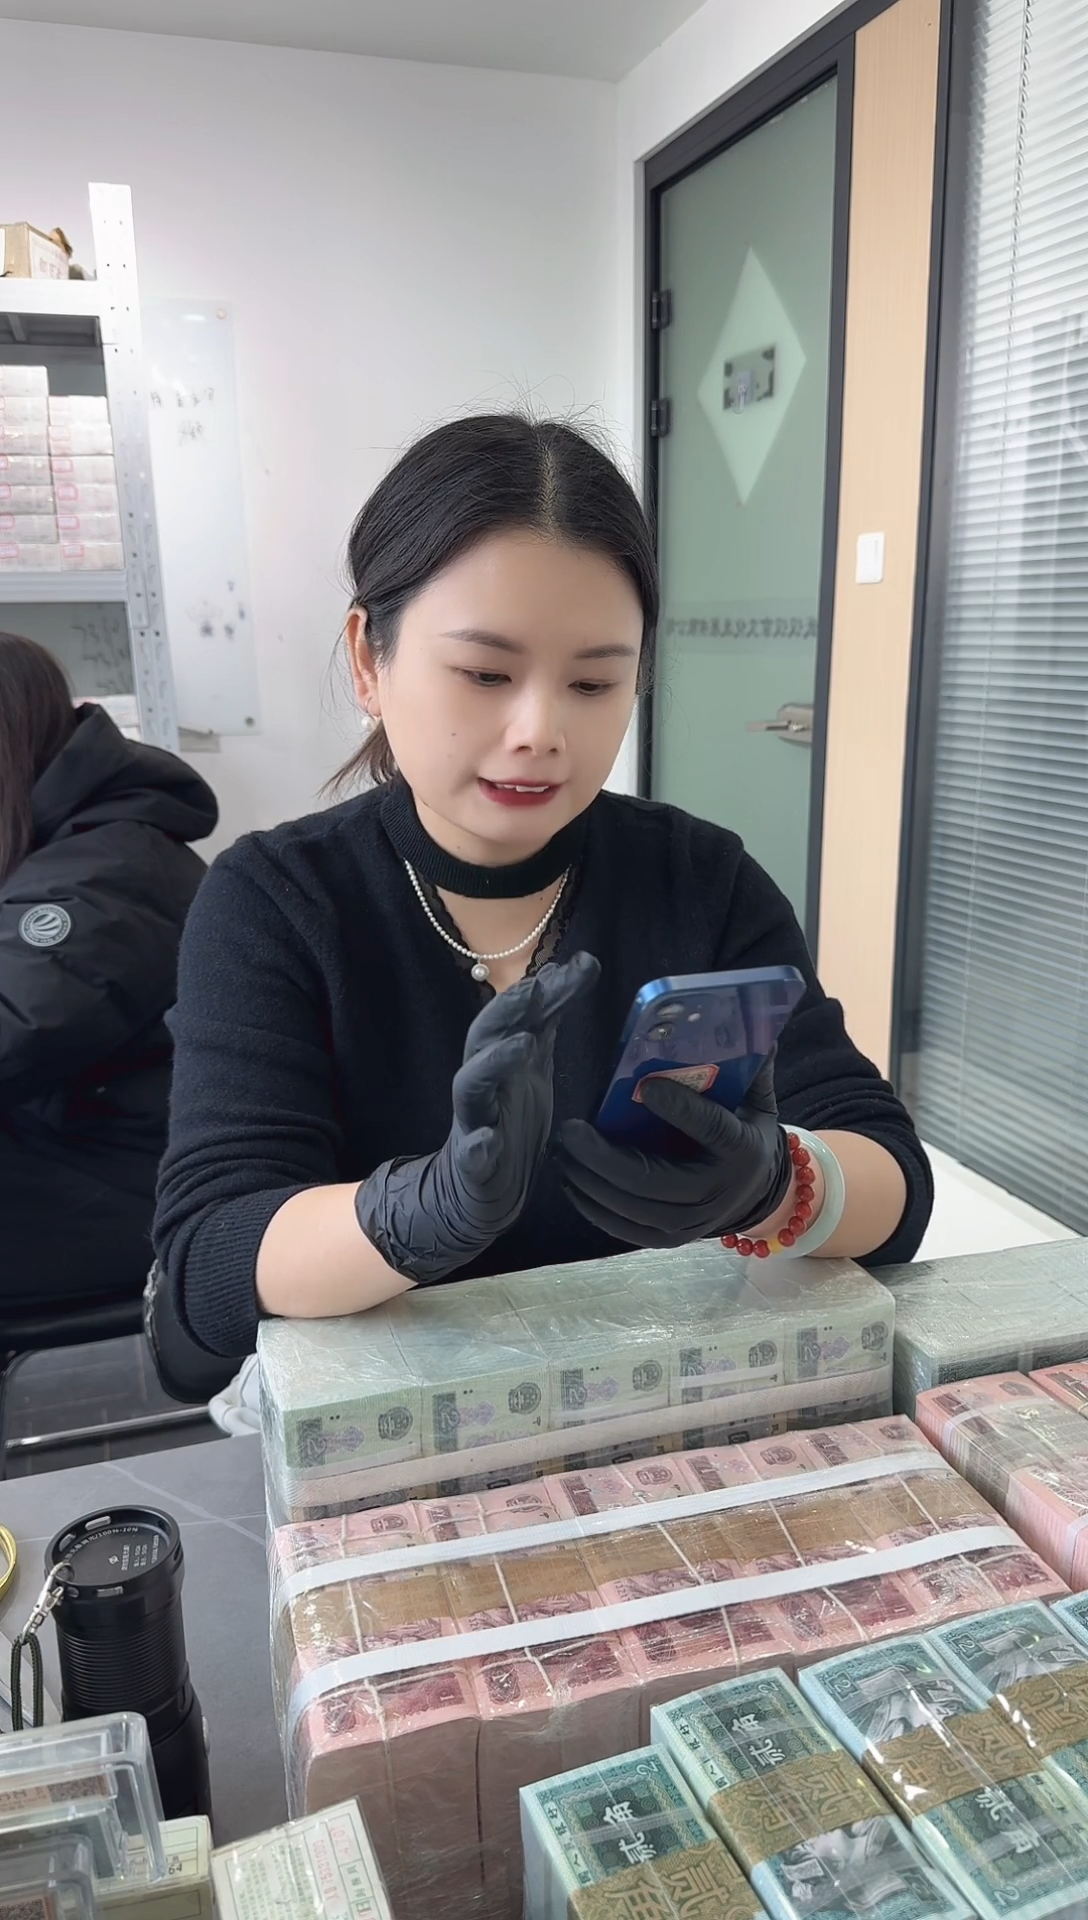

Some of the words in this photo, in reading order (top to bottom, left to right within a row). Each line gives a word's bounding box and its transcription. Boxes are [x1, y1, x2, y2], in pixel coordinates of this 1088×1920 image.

[758, 1681, 781, 1694] 2
[732, 1713, 786, 1767] 贰角
[636, 1761, 660, 1776] 2
[603, 1801, 657, 1864] 贰角
[994, 1884, 1020, 1905] 2
